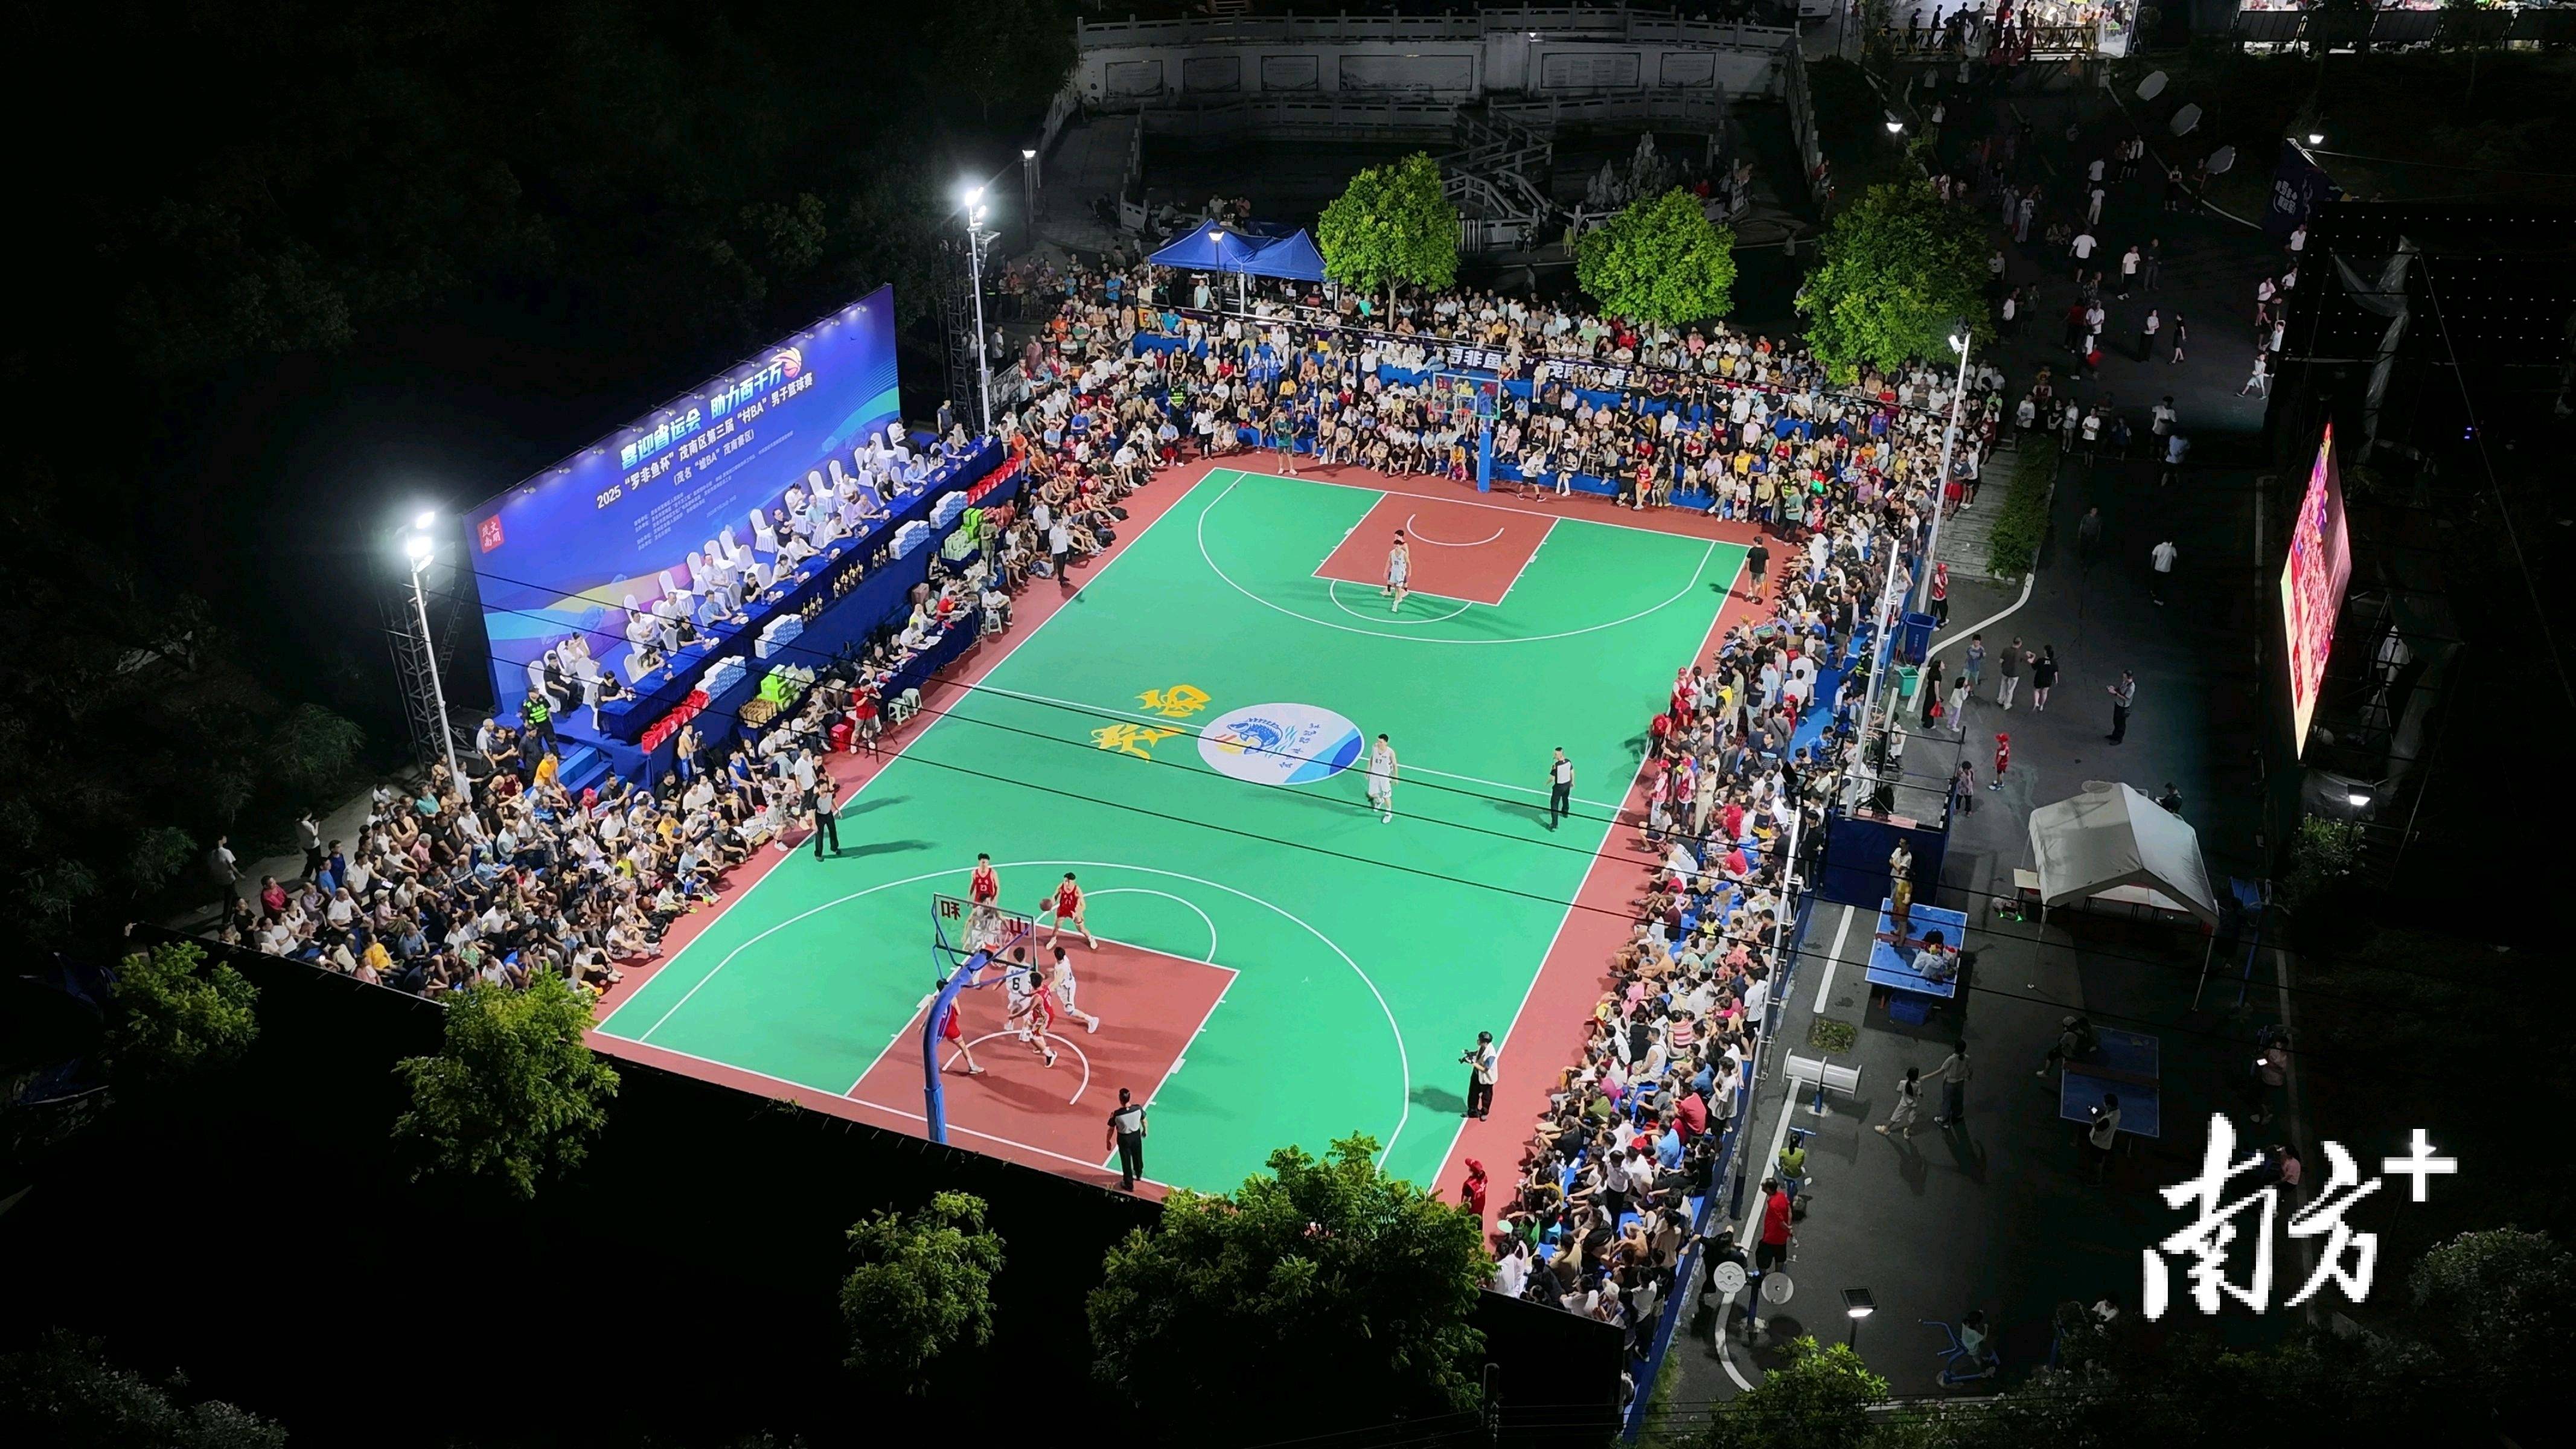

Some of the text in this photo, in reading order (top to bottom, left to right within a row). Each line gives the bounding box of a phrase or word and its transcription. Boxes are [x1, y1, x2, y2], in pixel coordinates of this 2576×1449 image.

[597, 485, 622, 509] 2025
[770, 372, 813, 407] 男子篮球赛
[621, 362, 783, 470] 喜迎省运会 助力百千万
[1012, 977, 1021, 991] 6
